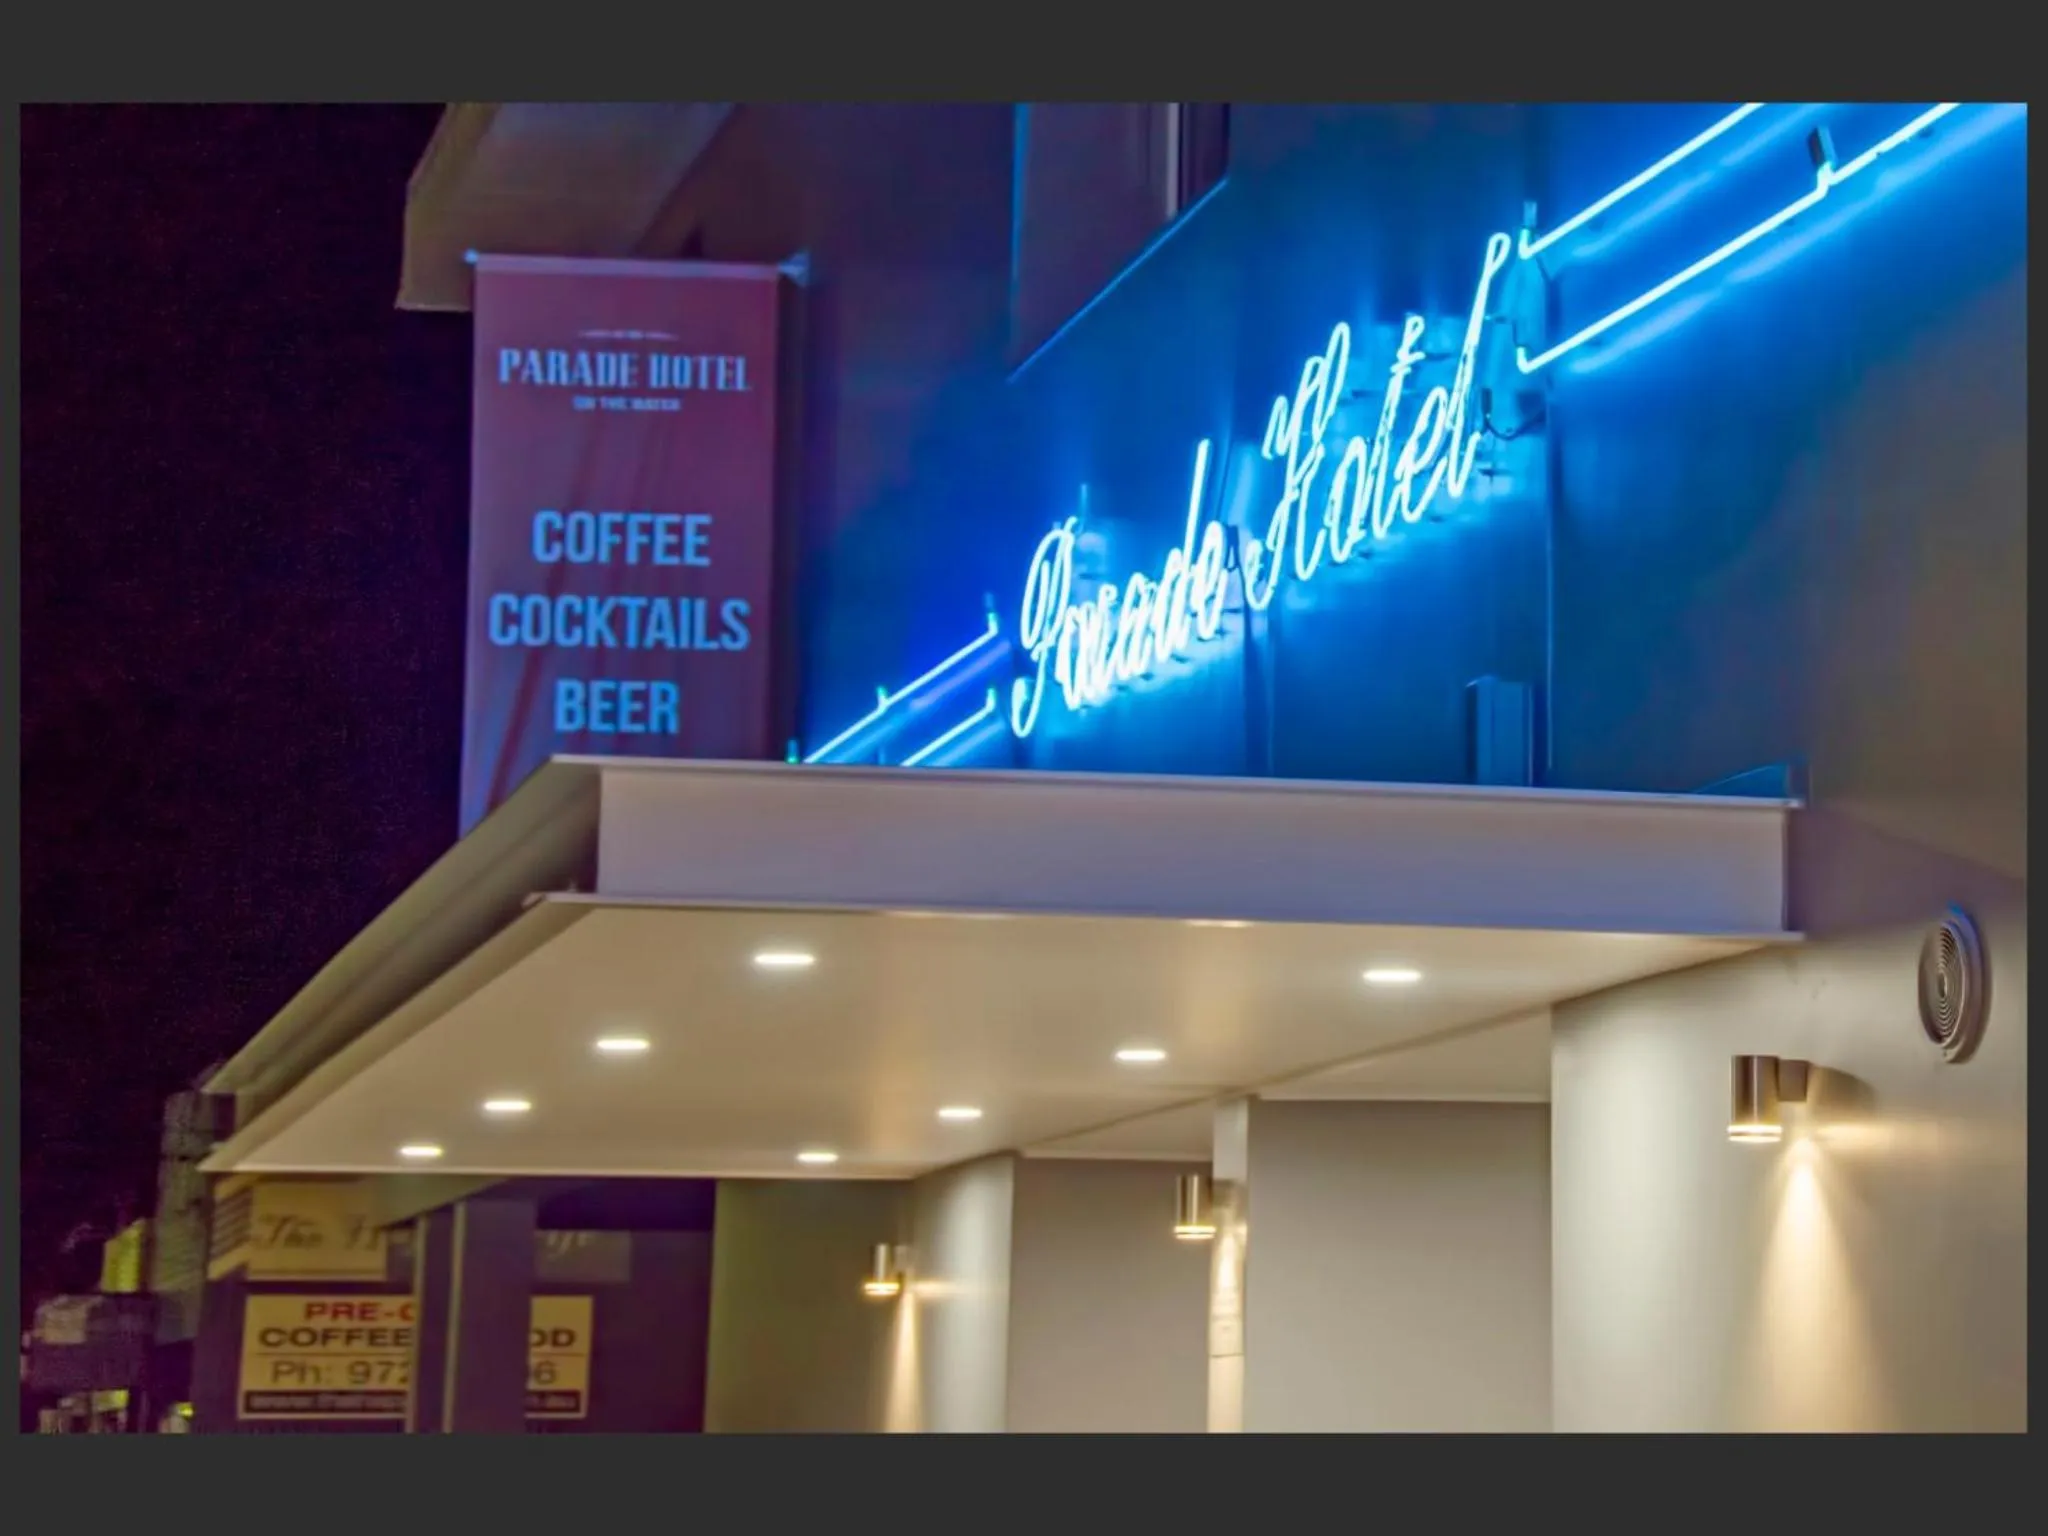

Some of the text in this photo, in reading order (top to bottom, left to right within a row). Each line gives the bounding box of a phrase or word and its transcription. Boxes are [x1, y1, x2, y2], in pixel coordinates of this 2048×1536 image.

[499, 347, 751, 392] PARADE HOTEL
[1012, 232, 1511, 738] Parade Hotel
[531, 510, 712, 567] COFFEE
[488, 593, 751, 652] COCKTAILS
[553, 678, 681, 735] BEER
[259, 1327, 412, 1348] COFFEE
